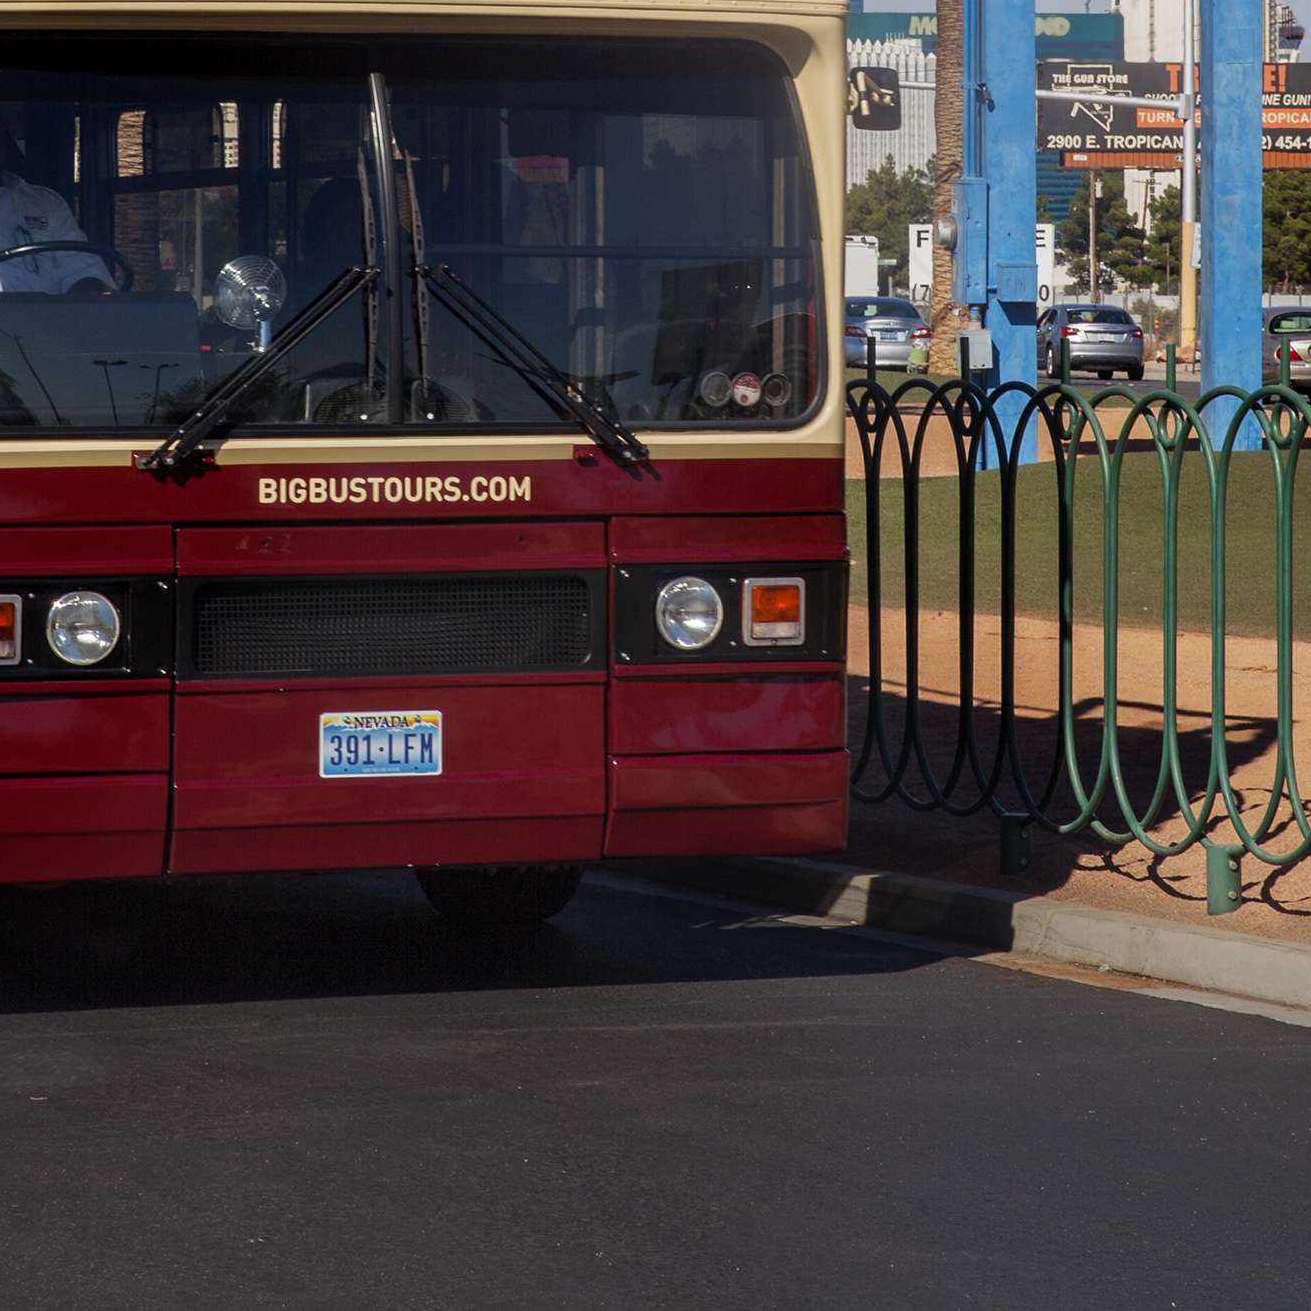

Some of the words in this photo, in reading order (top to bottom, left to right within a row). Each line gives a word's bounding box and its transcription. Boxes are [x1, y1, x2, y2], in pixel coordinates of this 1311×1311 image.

[1052, 74, 1071, 84] THE
[1073, 74, 1094, 84] GUN
[1096, 74, 1128, 84] STORE
[1282, 94, 1311, 106] GUN!
[1138, 111, 1175, 123] TURN
[1047, 135, 1081, 149] 2900
[1086, 135, 1100, 149] E.
[1103, 135, 1183, 149] TROPICAN
[257, 475, 533, 504] BIGBUSTOURS.COM
[353, 715, 411, 729] NEVADA
